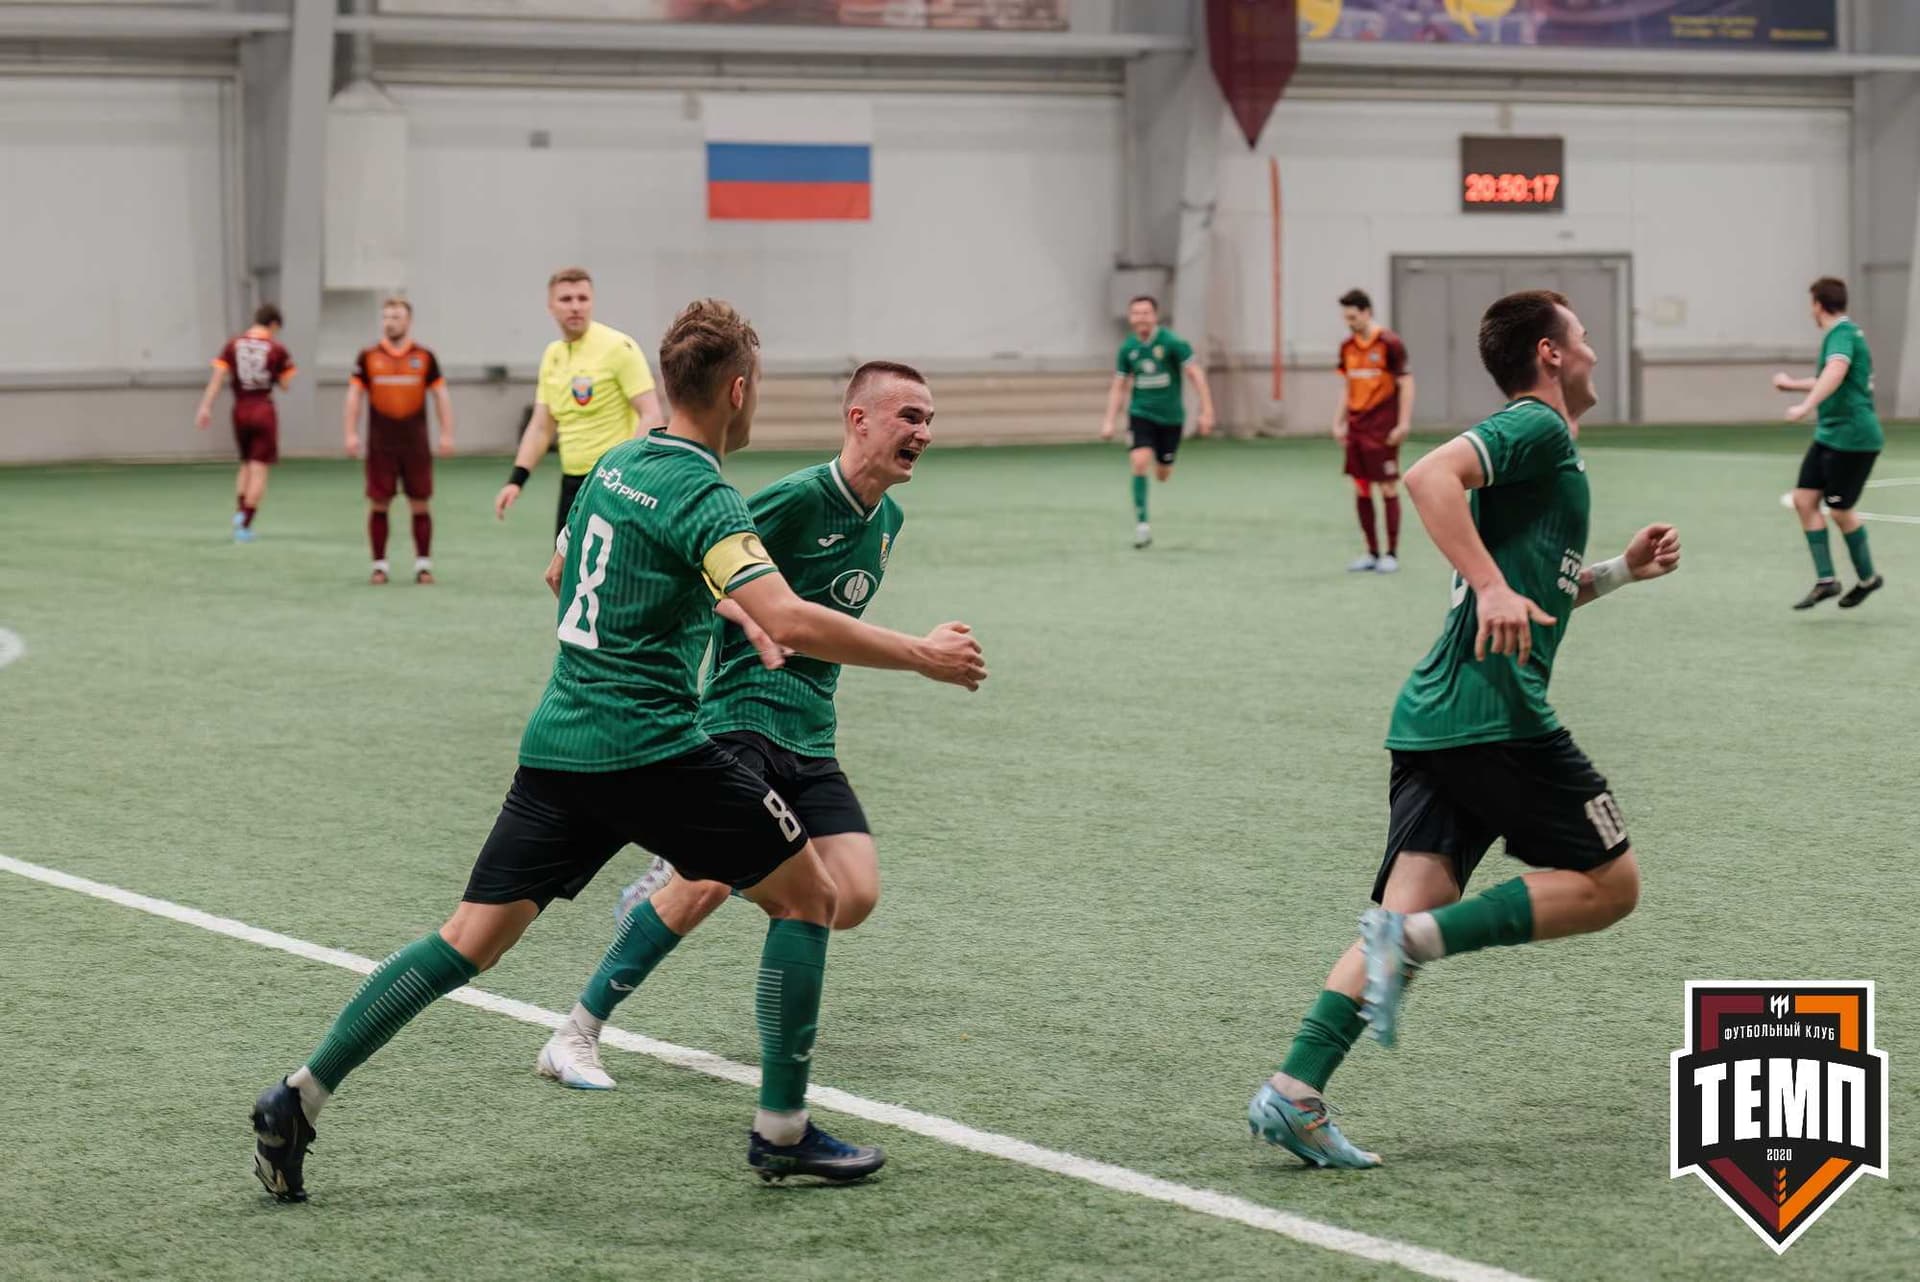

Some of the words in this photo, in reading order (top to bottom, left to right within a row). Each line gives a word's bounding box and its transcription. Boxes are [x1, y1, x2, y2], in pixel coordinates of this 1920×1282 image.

[1464, 173, 1559, 202] 20:50:17
[557, 513, 614, 650] 8
[763, 789, 802, 842] 8
